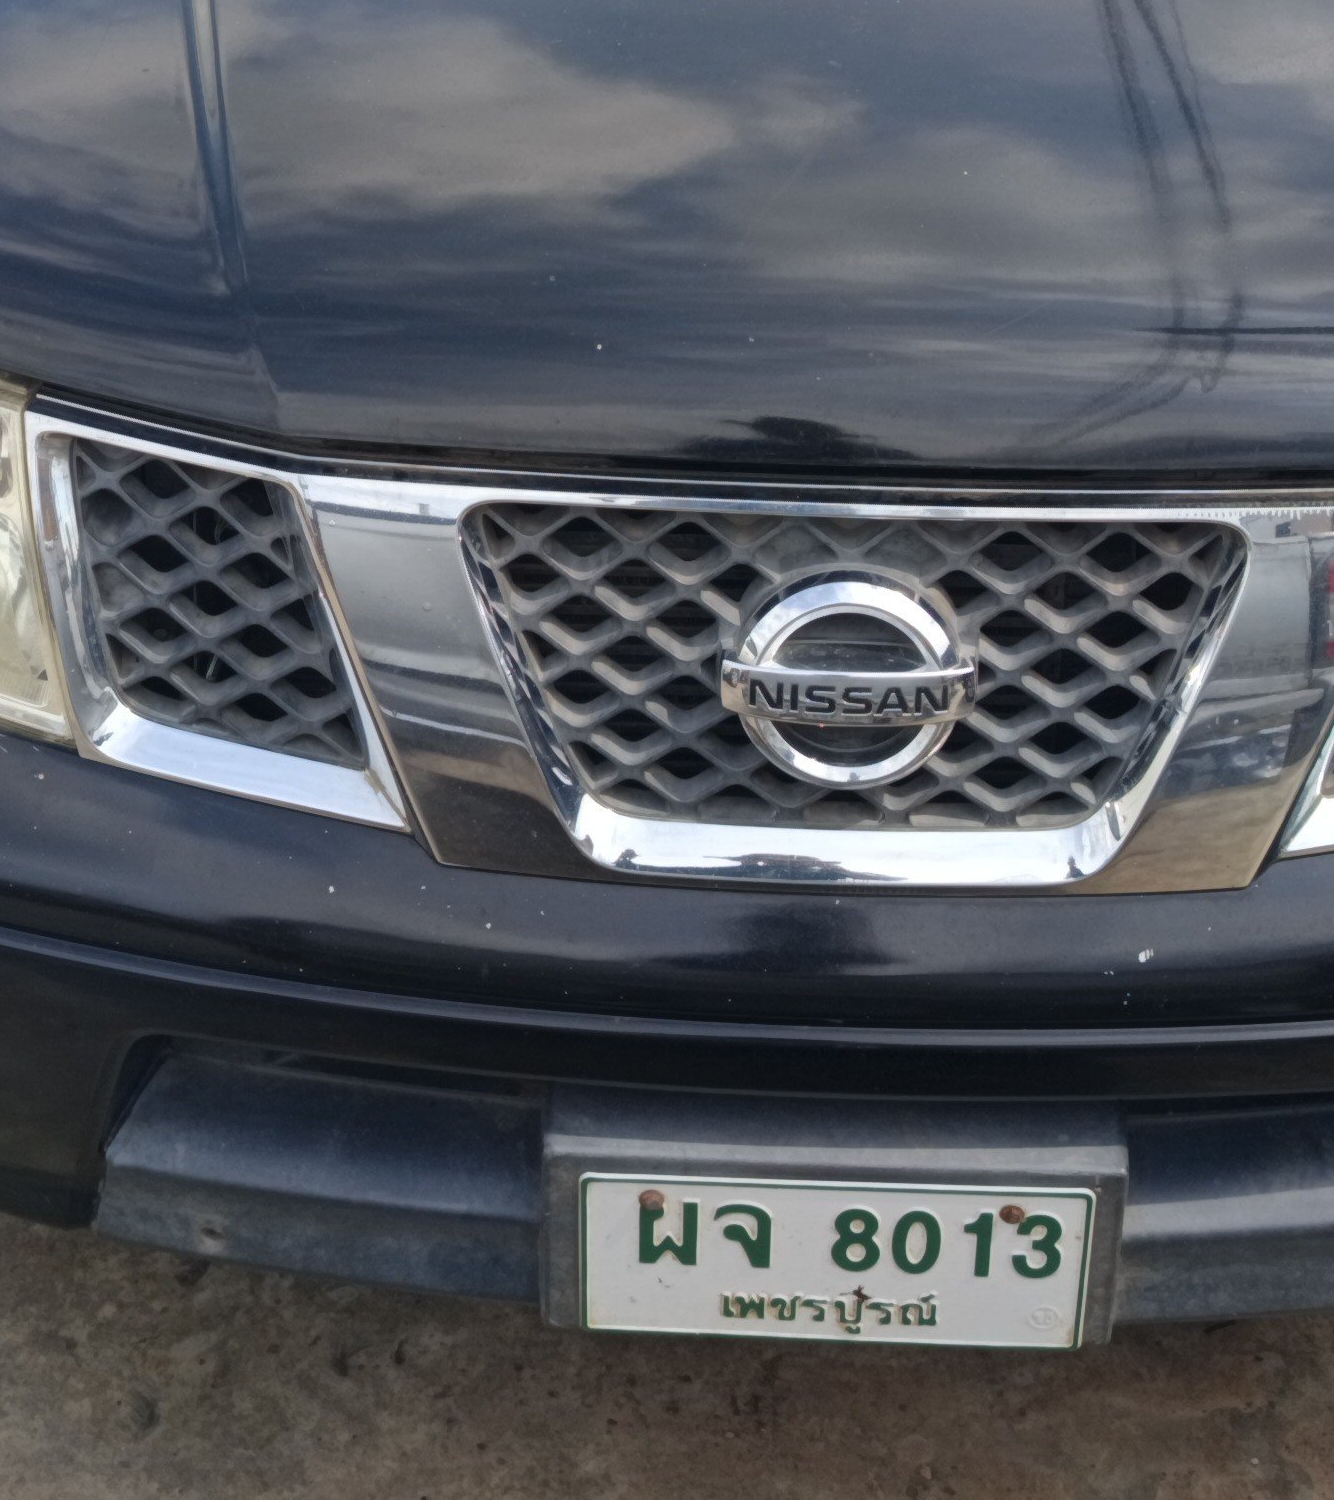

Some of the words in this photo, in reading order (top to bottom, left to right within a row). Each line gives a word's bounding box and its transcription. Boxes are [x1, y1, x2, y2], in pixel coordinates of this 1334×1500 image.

[749, 678, 950, 716] NISSAN
[638, 1196, 772, 1268] ผจ
[831, 1207, 1063, 1279] 8013
[720, 1292, 939, 1334] เพชรบูรณ์
